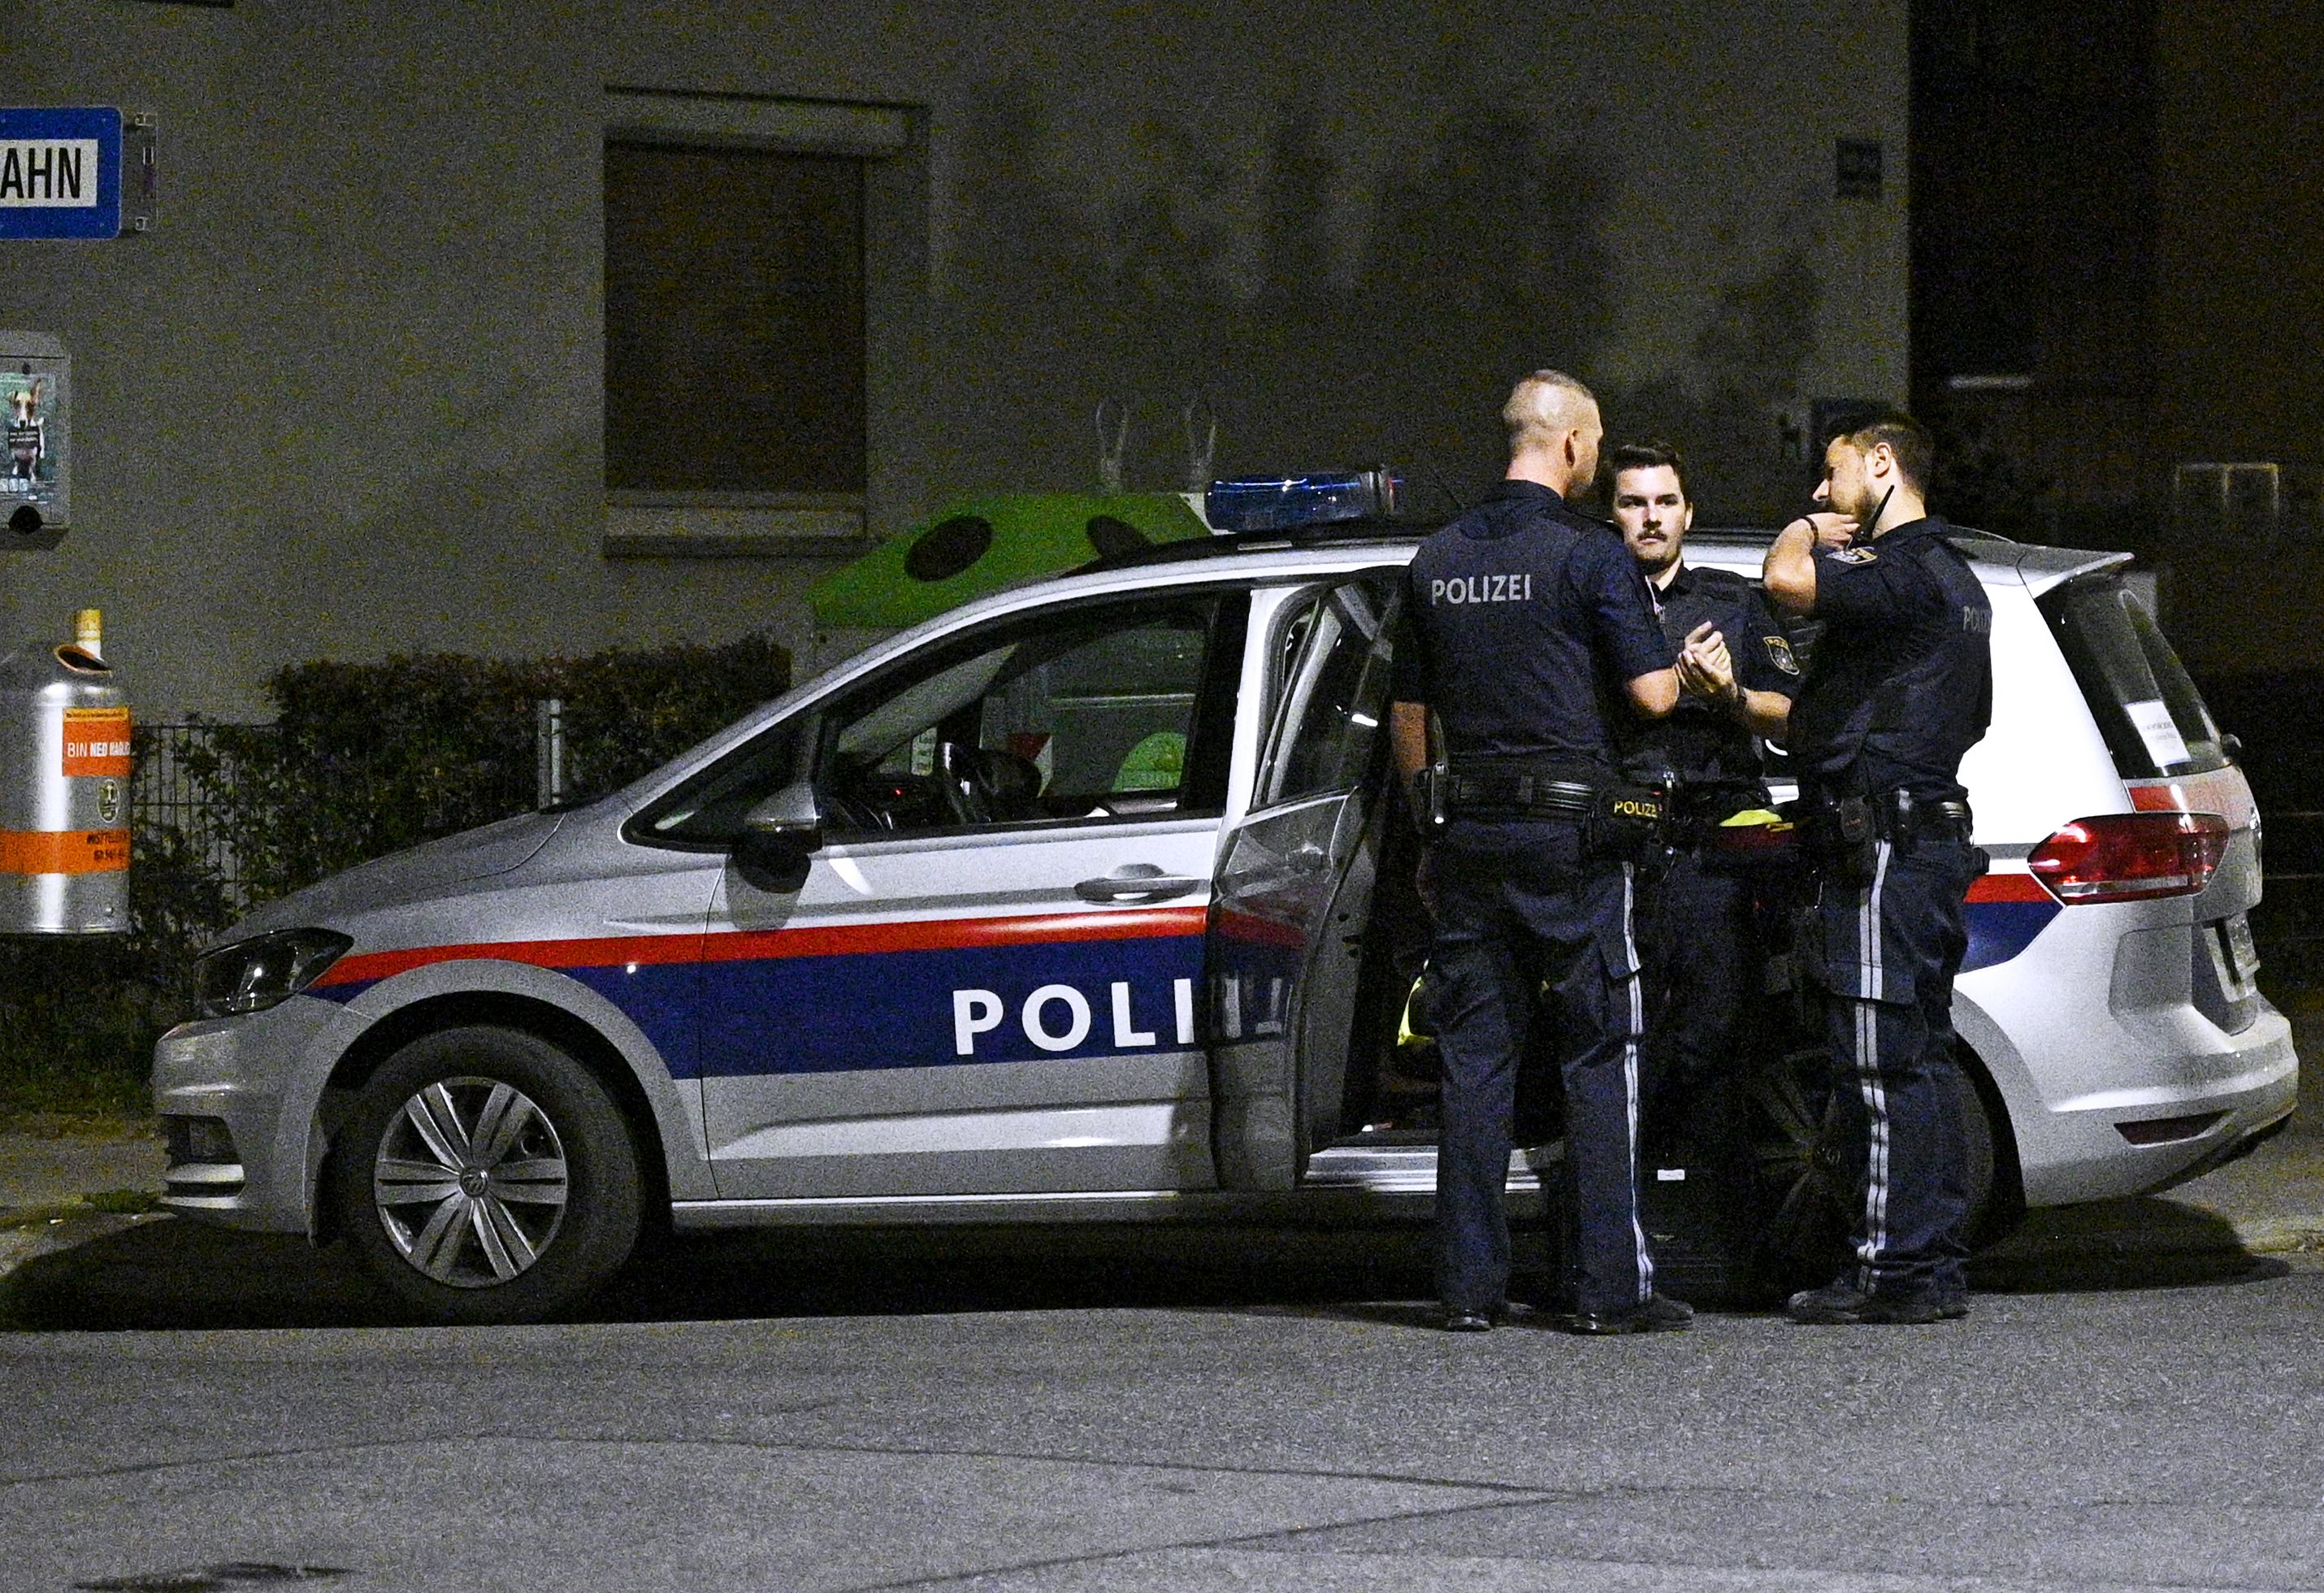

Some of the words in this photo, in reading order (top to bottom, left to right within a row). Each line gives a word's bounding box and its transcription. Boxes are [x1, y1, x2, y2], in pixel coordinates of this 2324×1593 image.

[1, 147, 81, 199] AHN
[1431, 574, 1531, 606] POLIZEI
[67, 741, 88, 757] BIN
[952, 978, 1195, 1056] POLI
